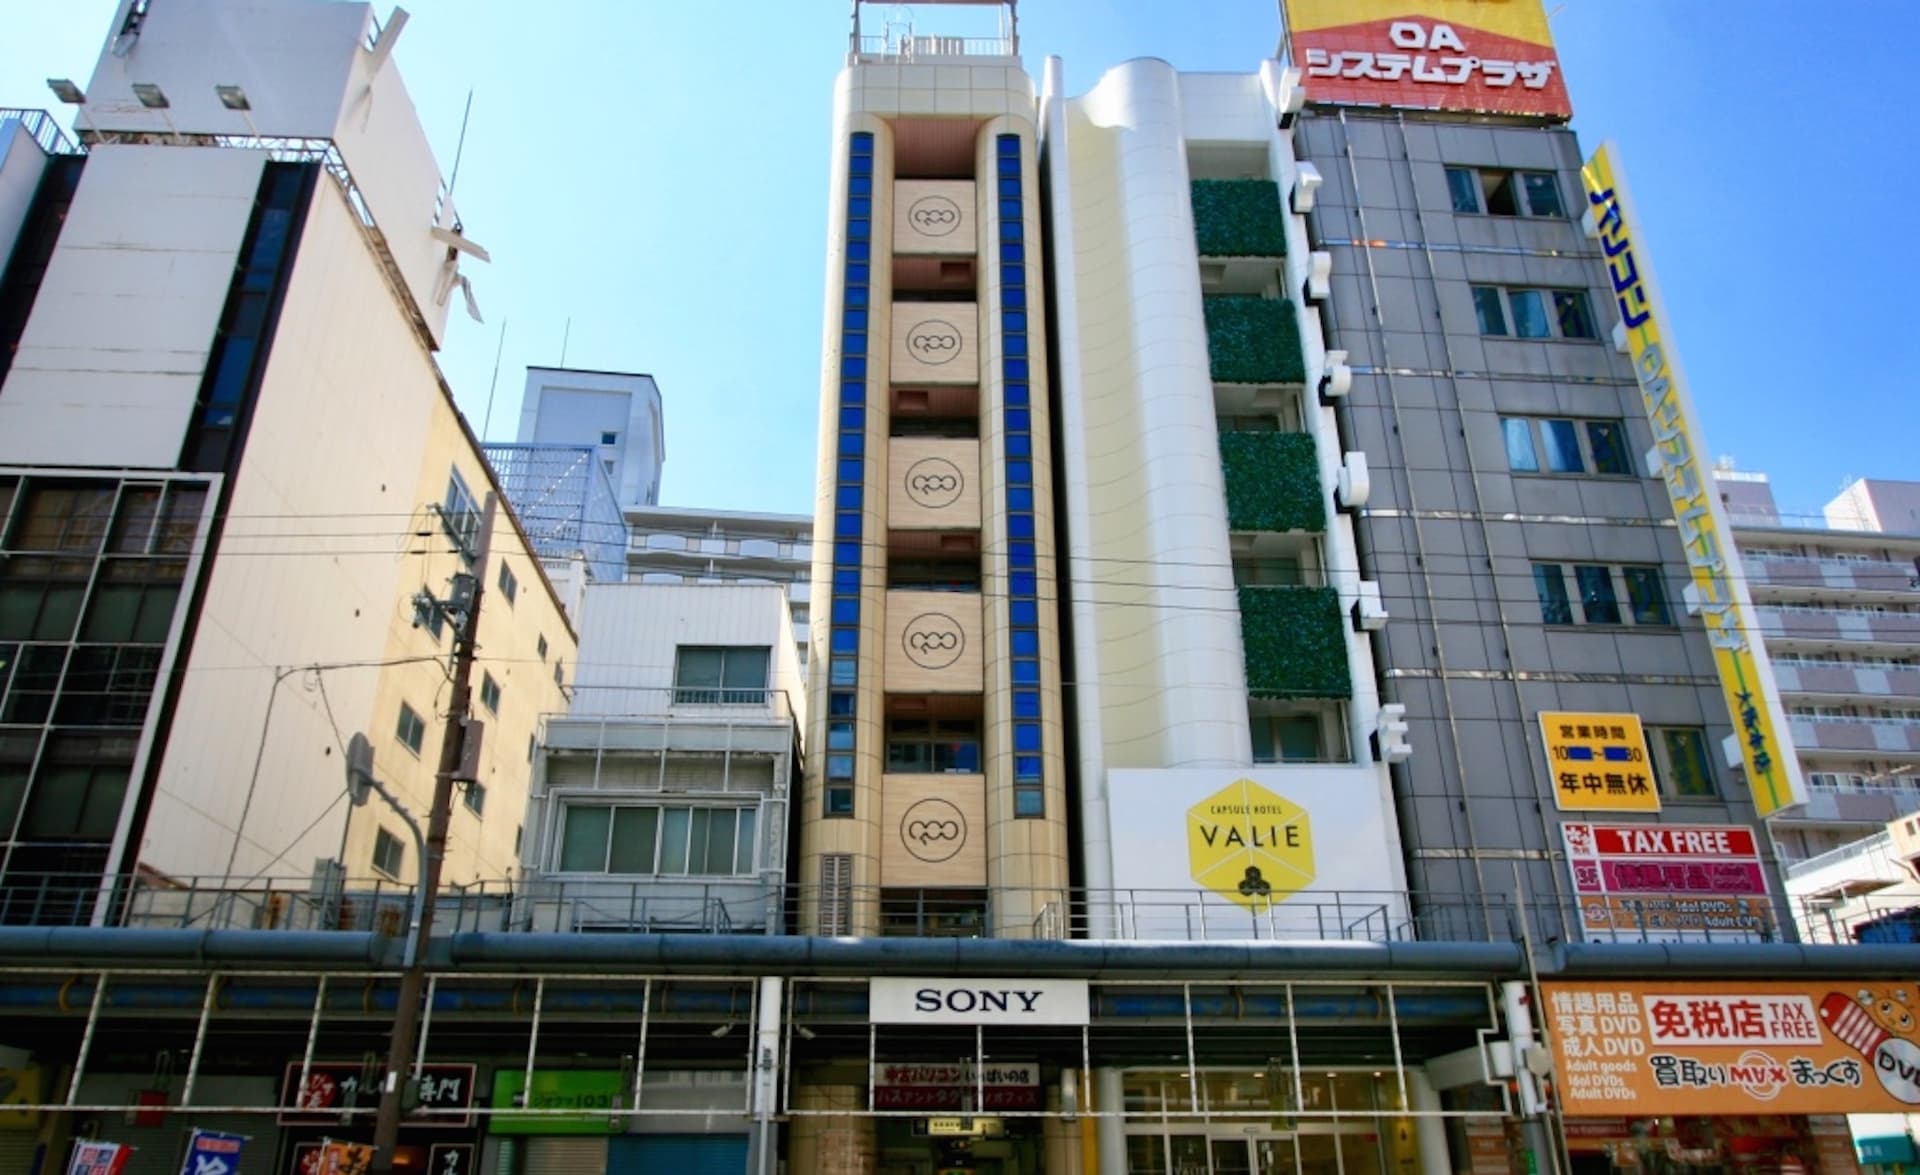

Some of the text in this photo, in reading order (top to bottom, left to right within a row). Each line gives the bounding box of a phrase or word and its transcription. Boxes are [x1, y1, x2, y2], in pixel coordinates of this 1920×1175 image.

[1389, 21, 1466, 52] OA
[1306, 48, 1556, 89] システムプラザ
[1560, 725, 1626, 740] 営業時間
[1560, 772, 1649, 795] 年中無休
[1211, 804, 1282, 815] CAPSULE HOTEL
[1200, 825, 1300, 848] VALIE
[1616, 830, 1732, 854] TAX FREE
[916, 989, 1043, 1012] SONY
[1552, 991, 1639, 1014] 情趣用品
[1768, 1003, 1807, 1020] TAX
[1651, 1000, 1767, 1039] 免税店
[1771, 1021, 1817, 1039] FREE
[1600, 1060, 1638, 1074] goods
[1568, 1075, 1624, 1087] Idol DVDs
[1571, 1087, 1637, 1099] Adult DVDs
